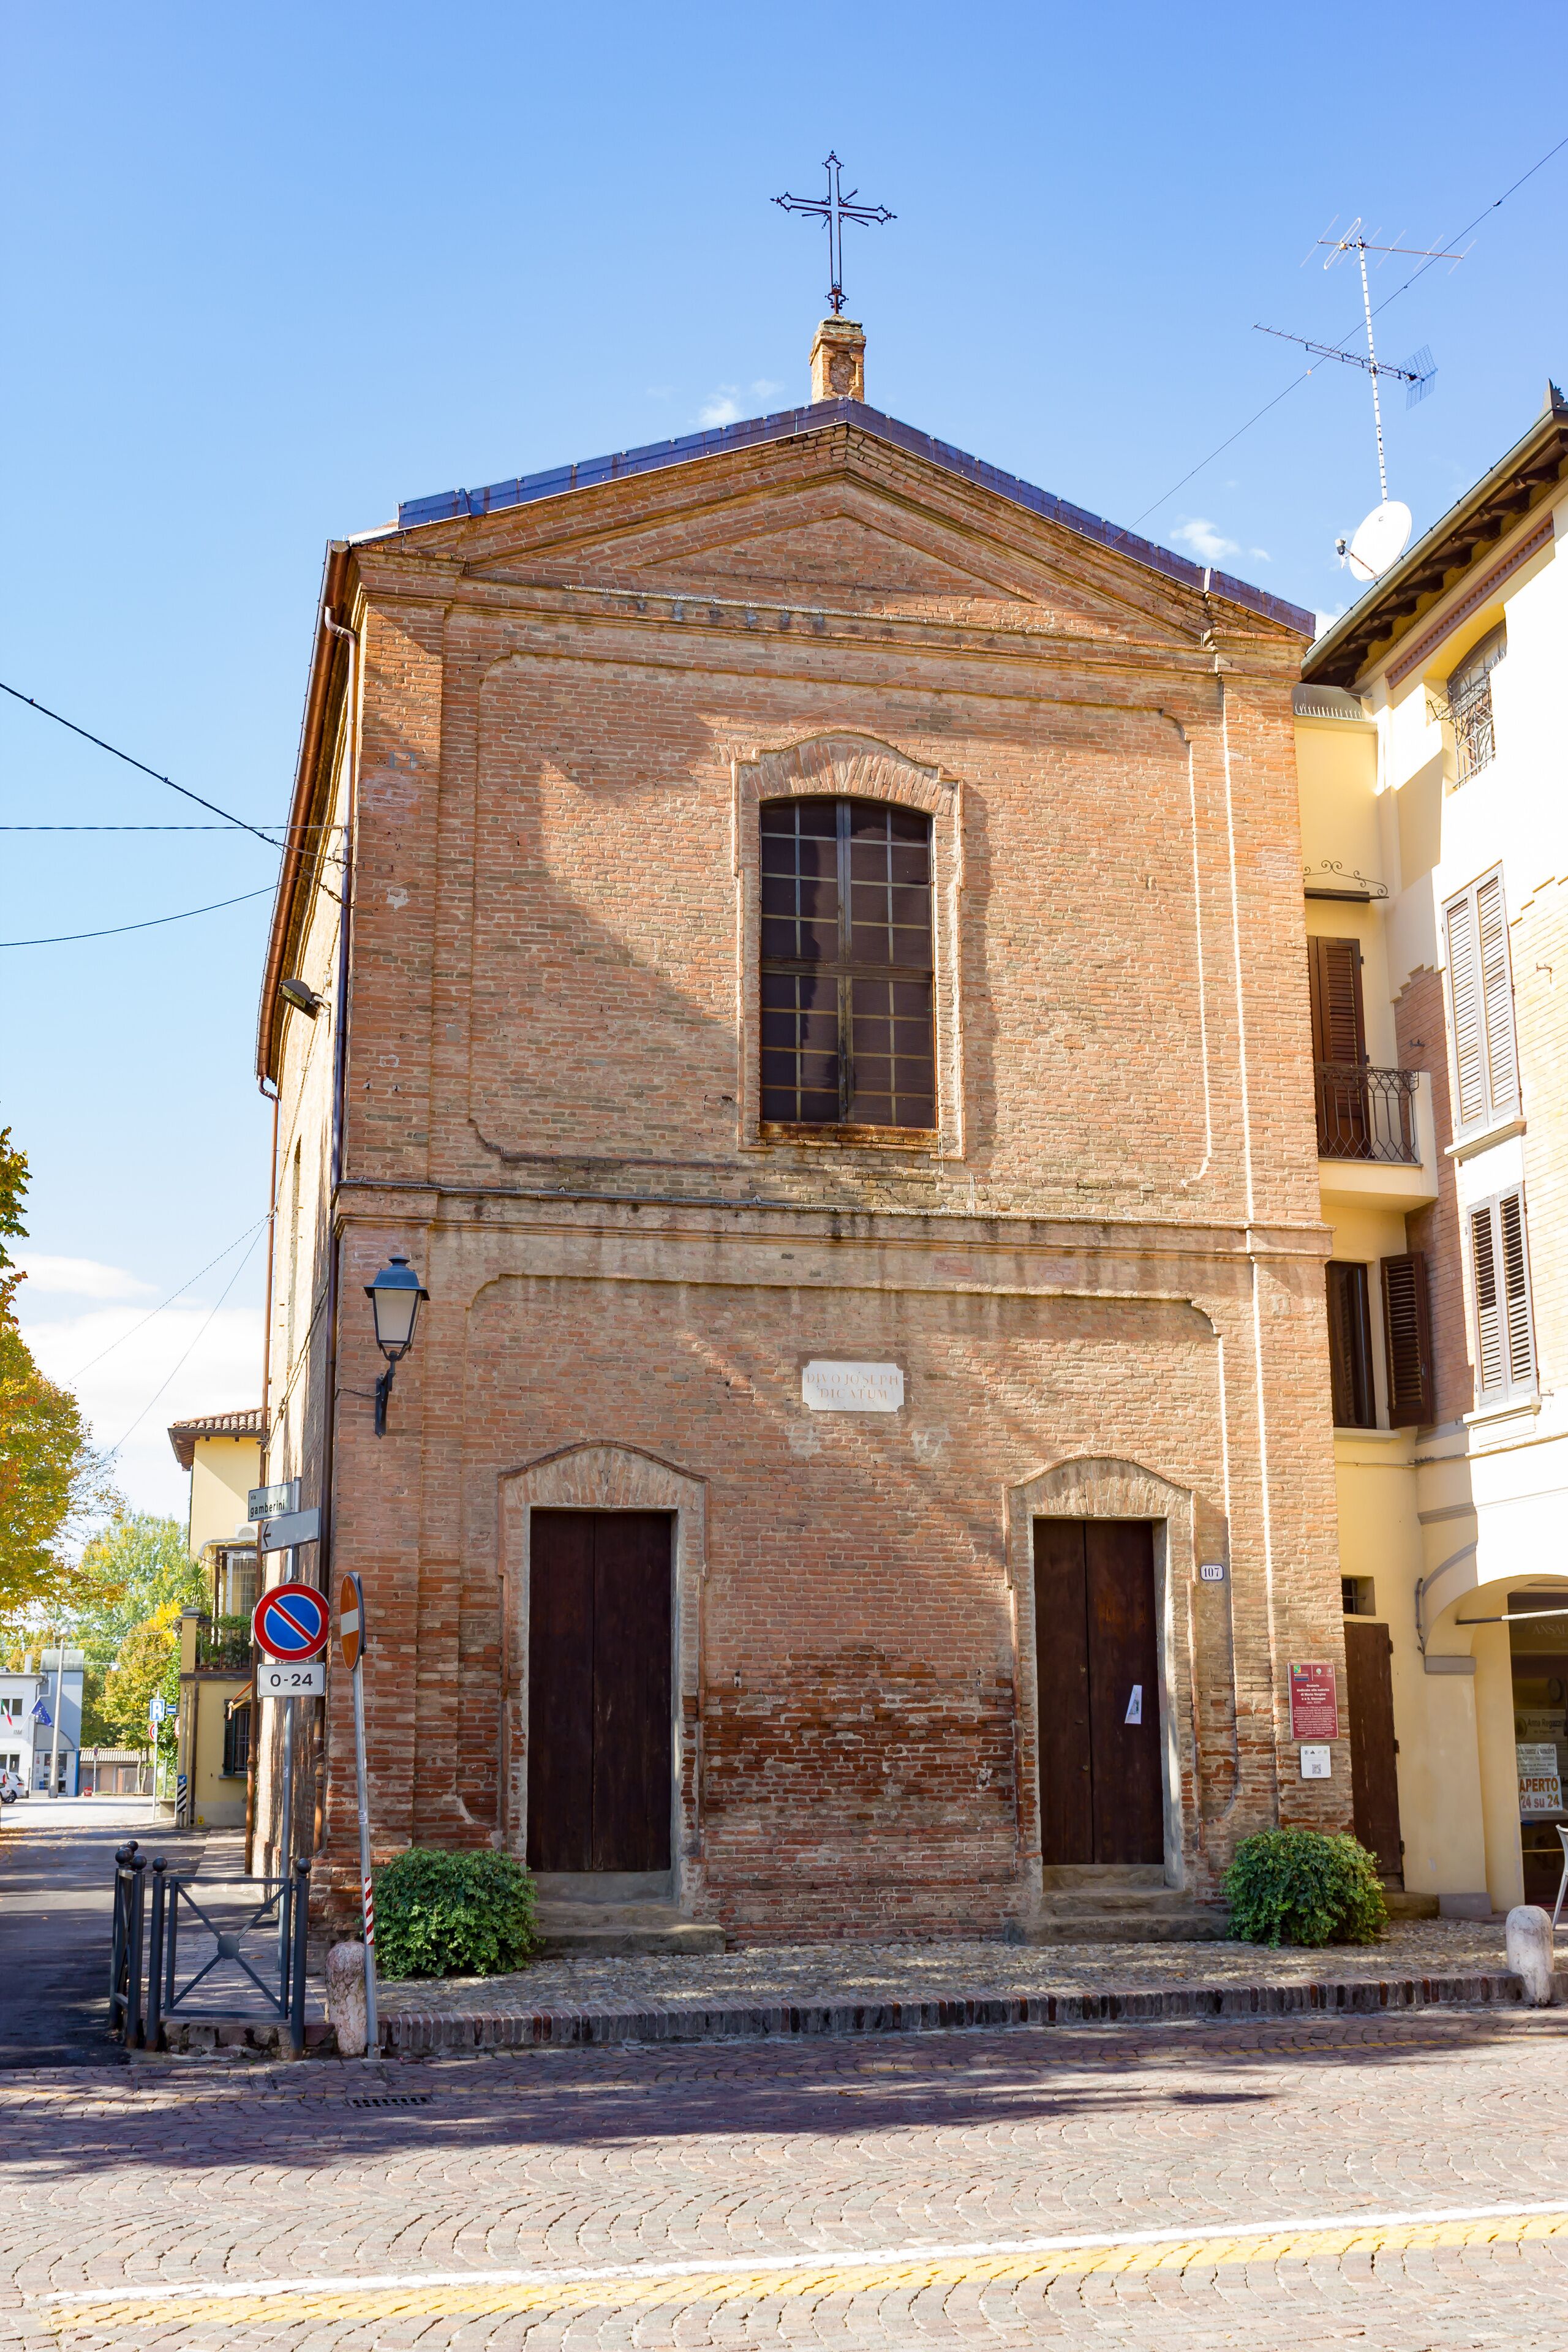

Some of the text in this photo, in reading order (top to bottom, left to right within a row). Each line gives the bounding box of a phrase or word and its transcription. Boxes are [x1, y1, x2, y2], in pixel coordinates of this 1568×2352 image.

[806, 1373, 841, 1384] DIVO
[250, 1499, 285, 1518] gamberini
[1204, 1567, 1219, 1577] 107
[1519, 1777, 1558, 1793] APERTO
[1521, 1794, 1559, 1809] 24 su 24
